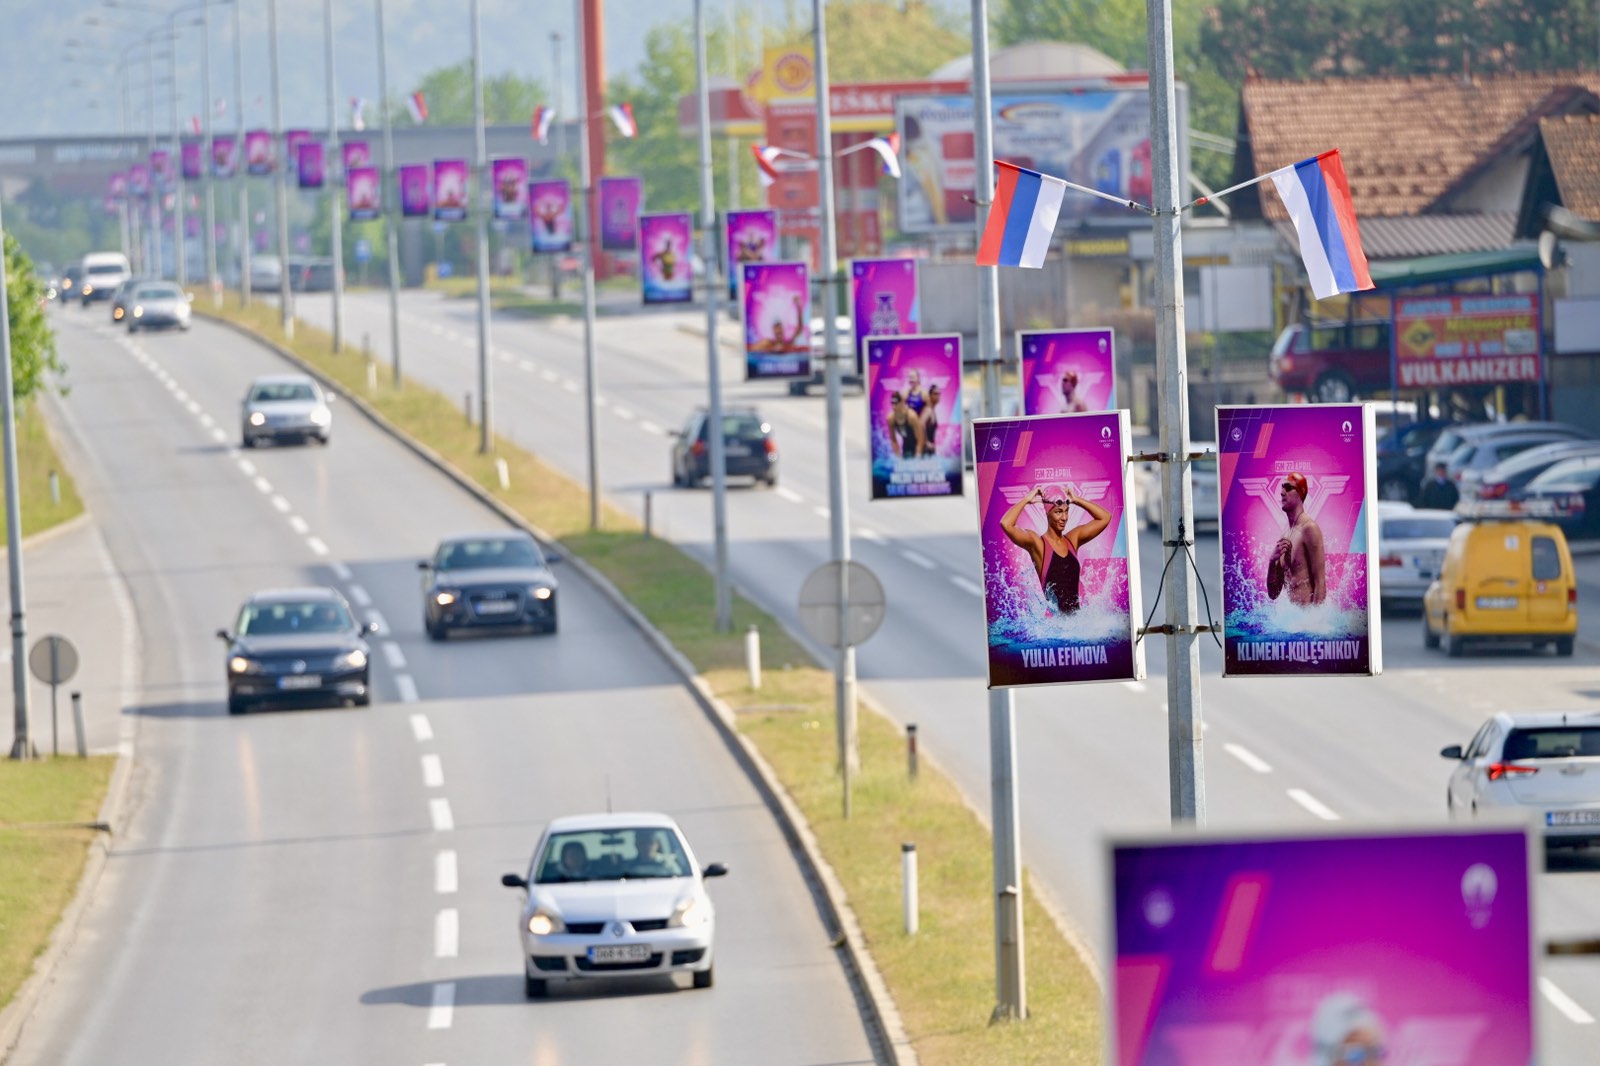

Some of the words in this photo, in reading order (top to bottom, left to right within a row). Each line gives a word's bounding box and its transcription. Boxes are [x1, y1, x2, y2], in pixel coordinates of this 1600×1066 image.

[1402, 357, 1536, 385] VULKANIZER
[1055, 467, 1072, 478] APRIL
[1294, 460, 1312, 471] APRIL
[1021, 648, 1056, 668] YULIA
[1058, 645, 1108, 666] EFIMOVA
[1237, 641, 1286, 661] KLIMENT
[1288, 640, 1360, 661] KOLESNIKOV
